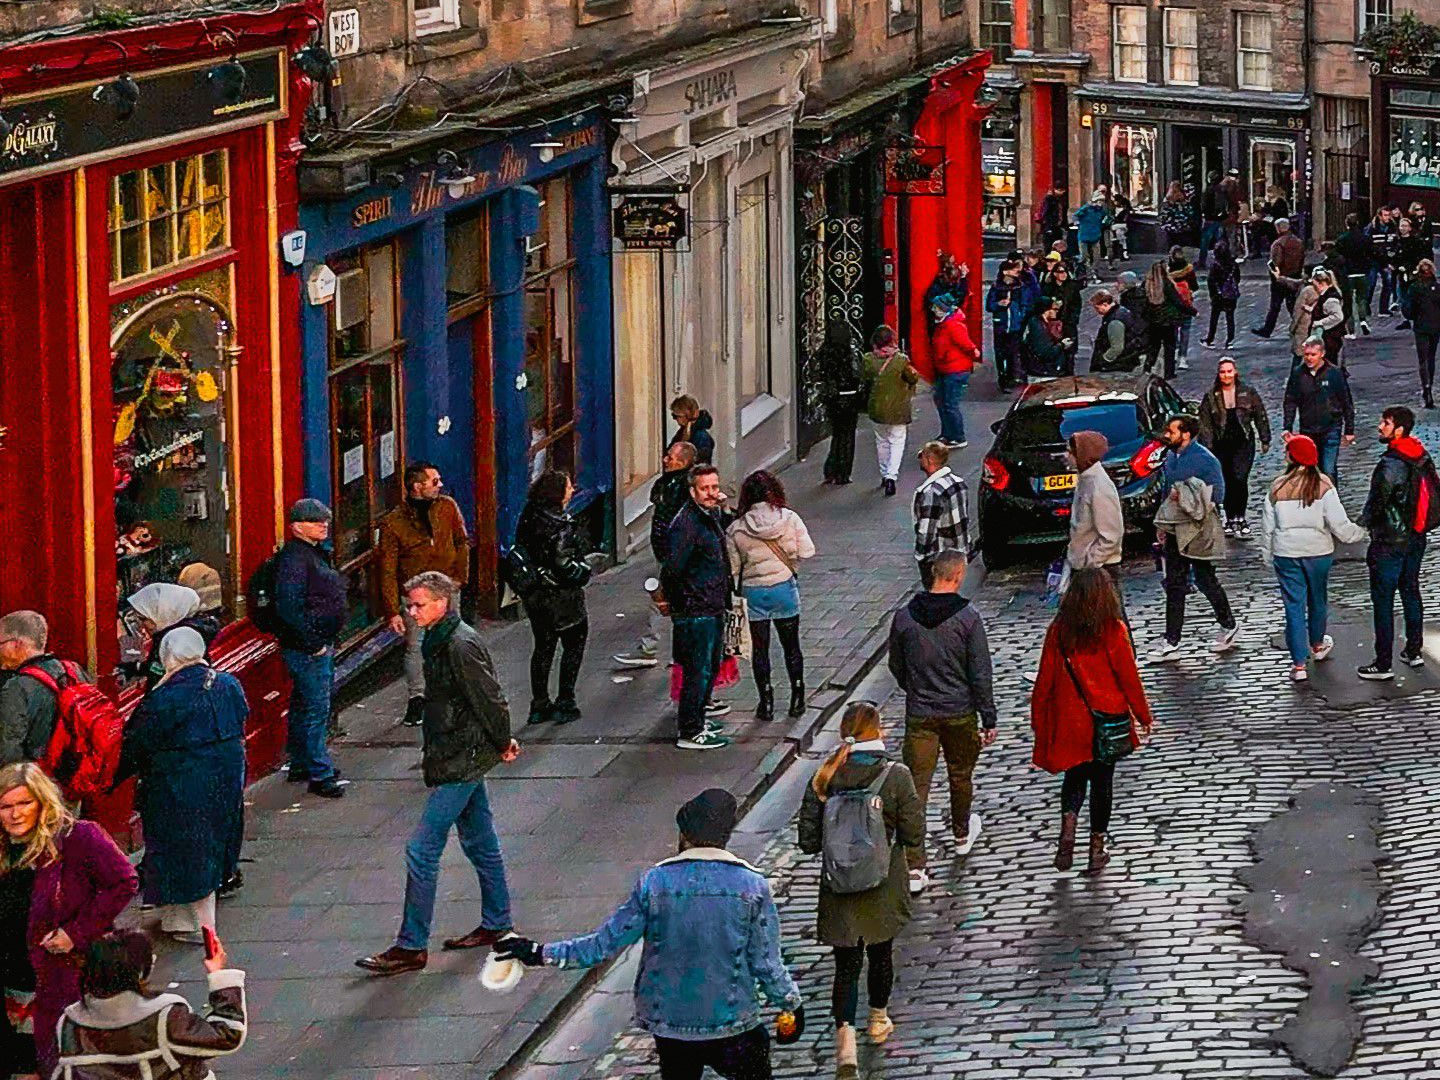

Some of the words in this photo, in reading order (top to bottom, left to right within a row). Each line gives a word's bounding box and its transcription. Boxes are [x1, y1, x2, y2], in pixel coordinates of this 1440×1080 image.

[332, 12, 356, 31] WEST
[334, 32, 355, 54] BOW
[685, 71, 738, 109] SAHARA
[13, 121, 57, 155] GALAXY
[353, 196, 392, 228] SPIRIT
[1048, 475, 1074, 488] GC14
